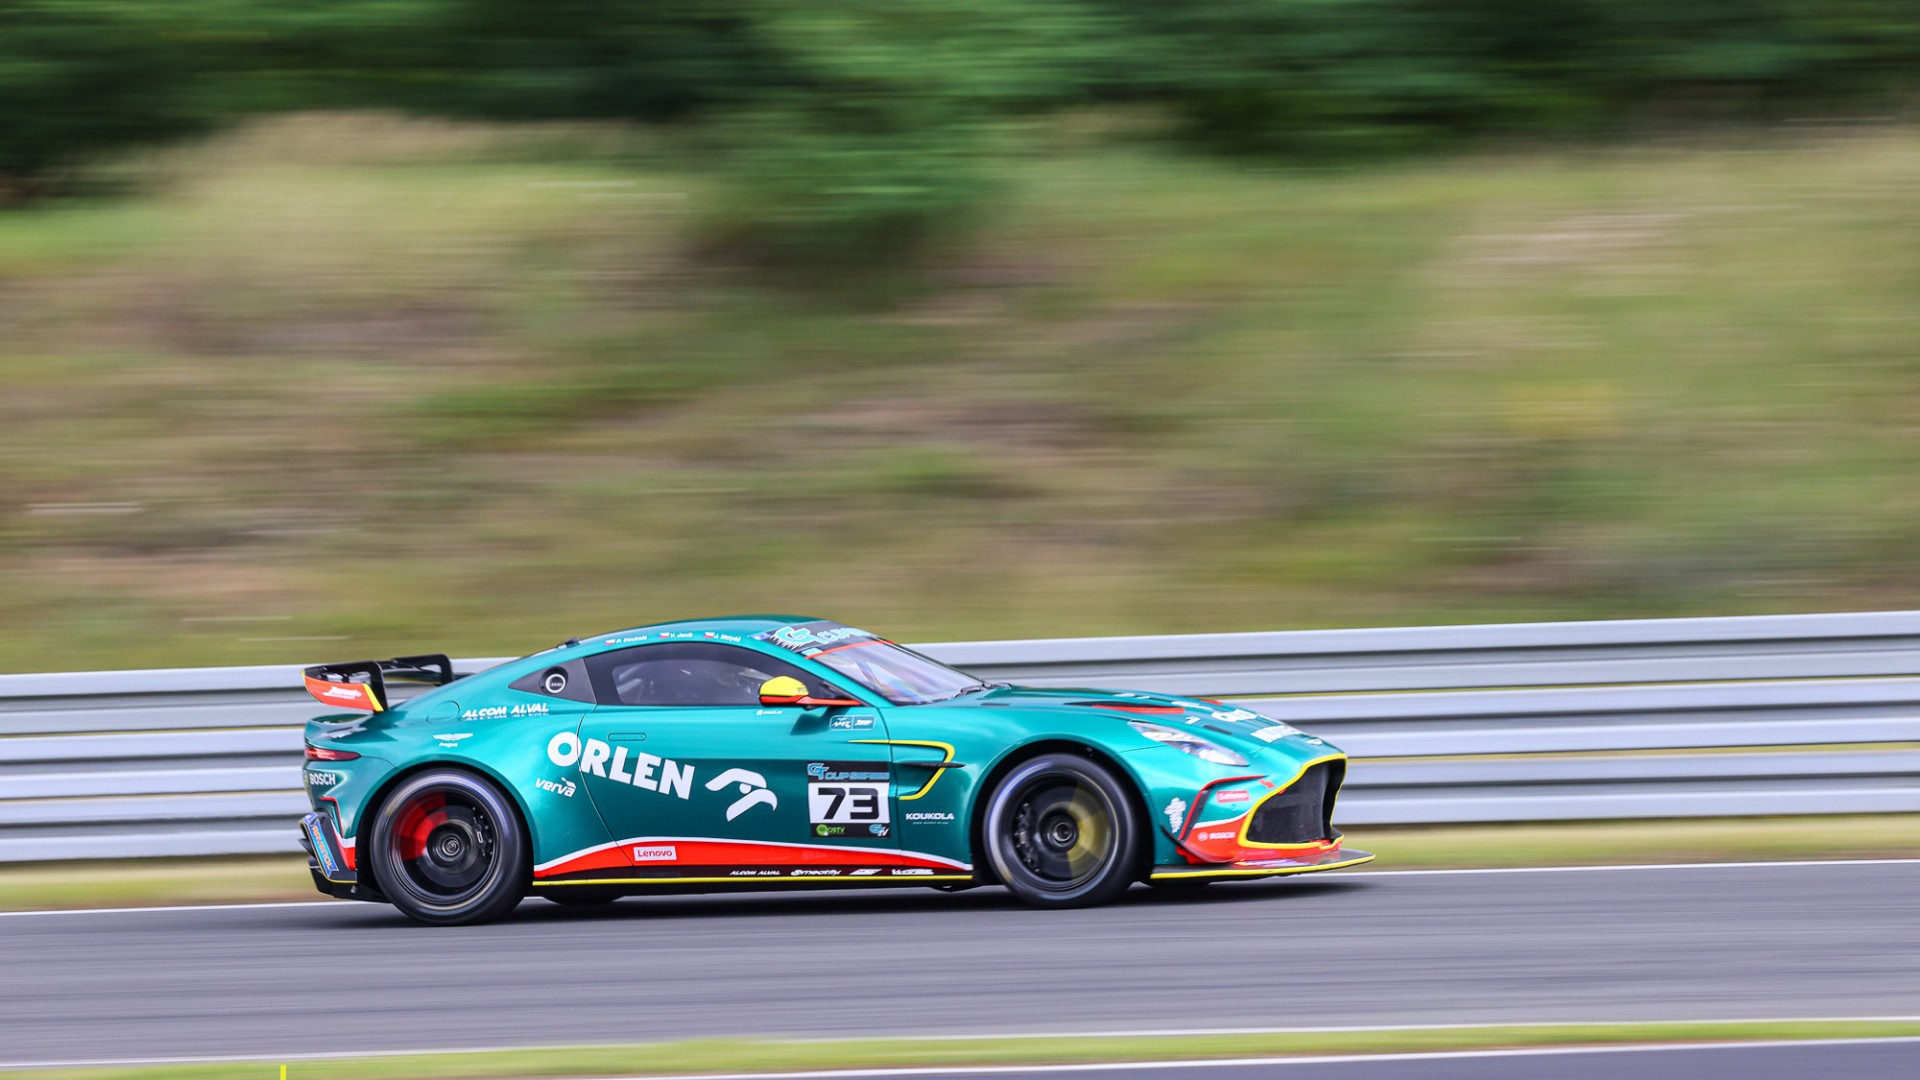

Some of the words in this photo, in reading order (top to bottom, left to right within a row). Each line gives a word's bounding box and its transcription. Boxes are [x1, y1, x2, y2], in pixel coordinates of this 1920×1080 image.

[462, 706, 507, 719] ALCOM
[511, 702, 549, 714] ALVAL
[547, 731, 695, 800] ORLEN
[309, 773, 336, 785] BOSCH
[535, 777, 577, 798] verva
[818, 787, 880, 820] 73
[905, 812, 955, 820] KOUKOLA
[637, 849, 673, 857] Lenovo
